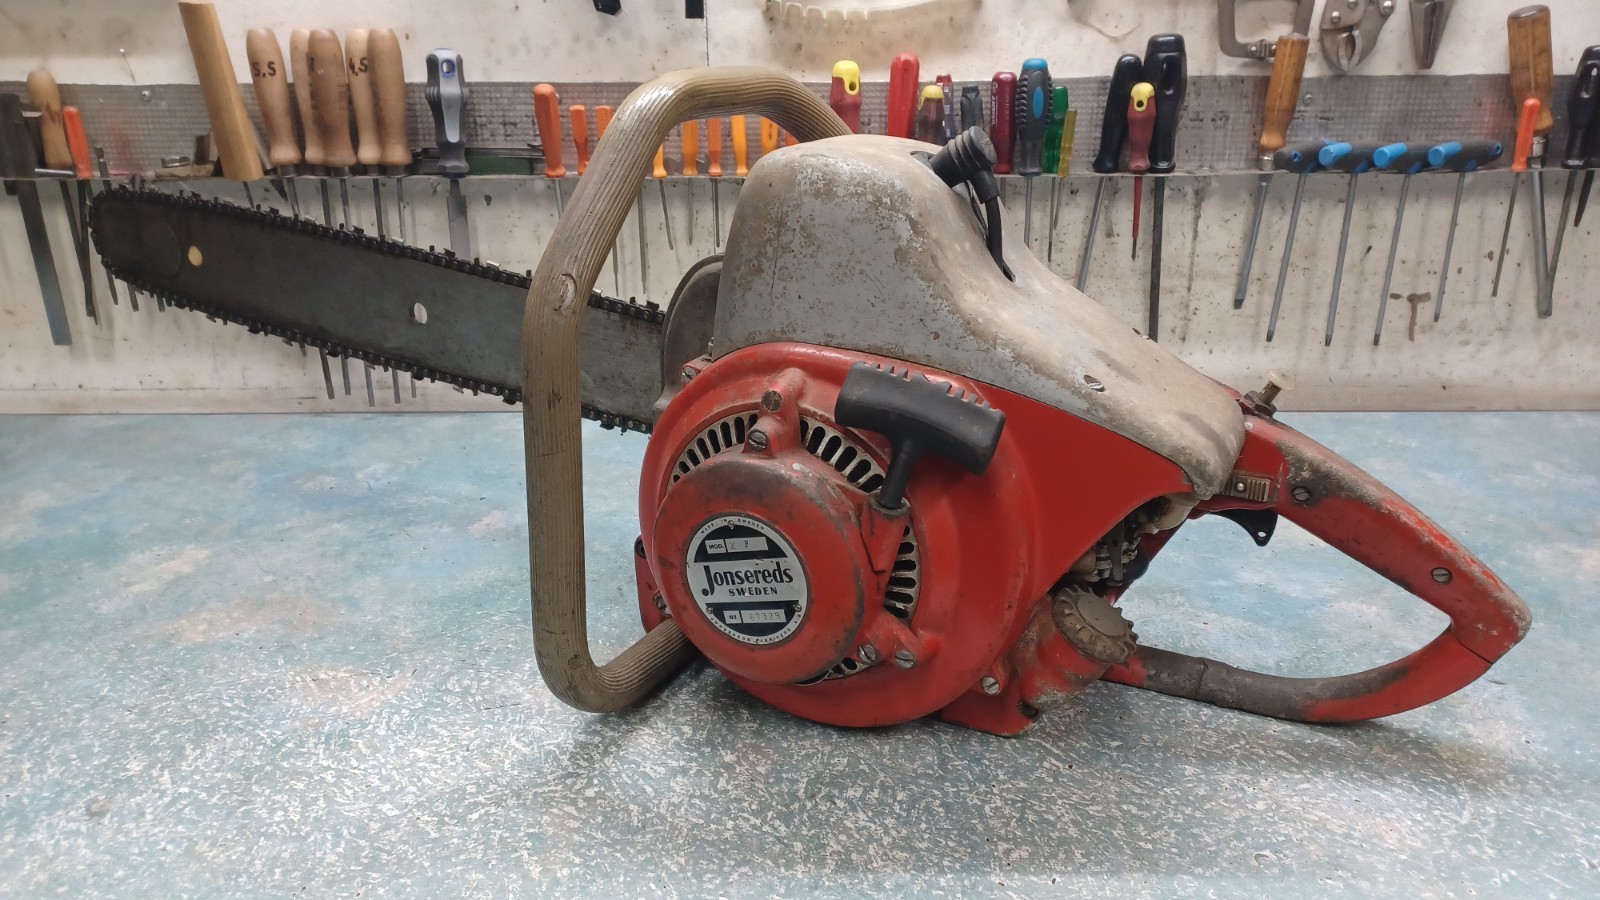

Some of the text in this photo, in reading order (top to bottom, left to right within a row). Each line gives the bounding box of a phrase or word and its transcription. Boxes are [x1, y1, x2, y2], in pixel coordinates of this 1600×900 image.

[738, 519, 764, 530] SWEDEN
[702, 561, 794, 596] Jonsereds
[728, 587, 778, 597] SWEDEN
